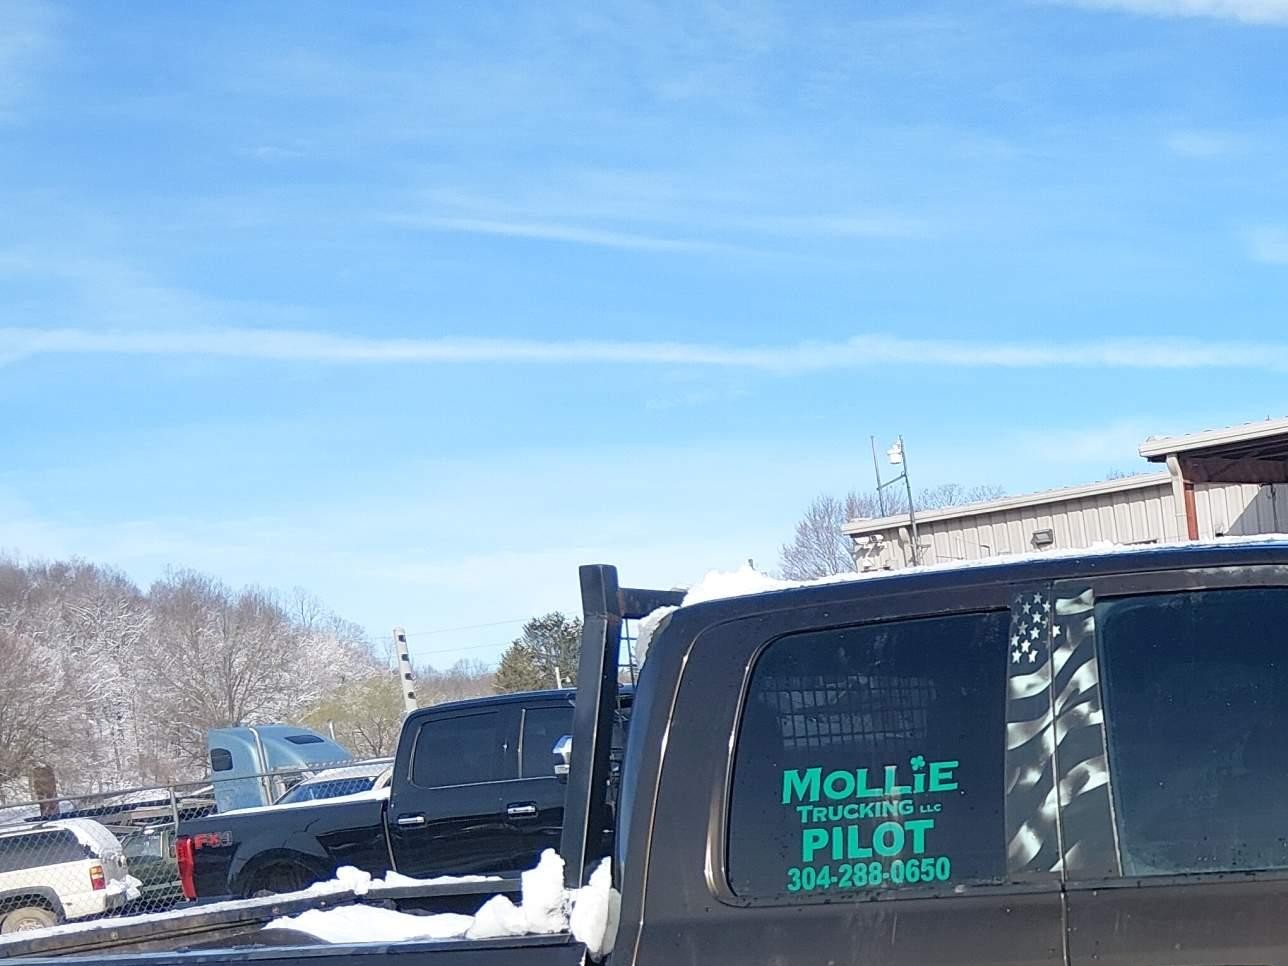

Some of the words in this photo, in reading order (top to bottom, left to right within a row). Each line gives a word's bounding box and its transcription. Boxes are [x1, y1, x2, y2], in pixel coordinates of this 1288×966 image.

[796, 799, 914, 823] TRUCKING
[919, 803, 942, 813] LLC
[194, 830, 233, 849] FX4
[802, 819, 935, 862] PILOT
[787, 856, 951, 891] 304-288-0650
